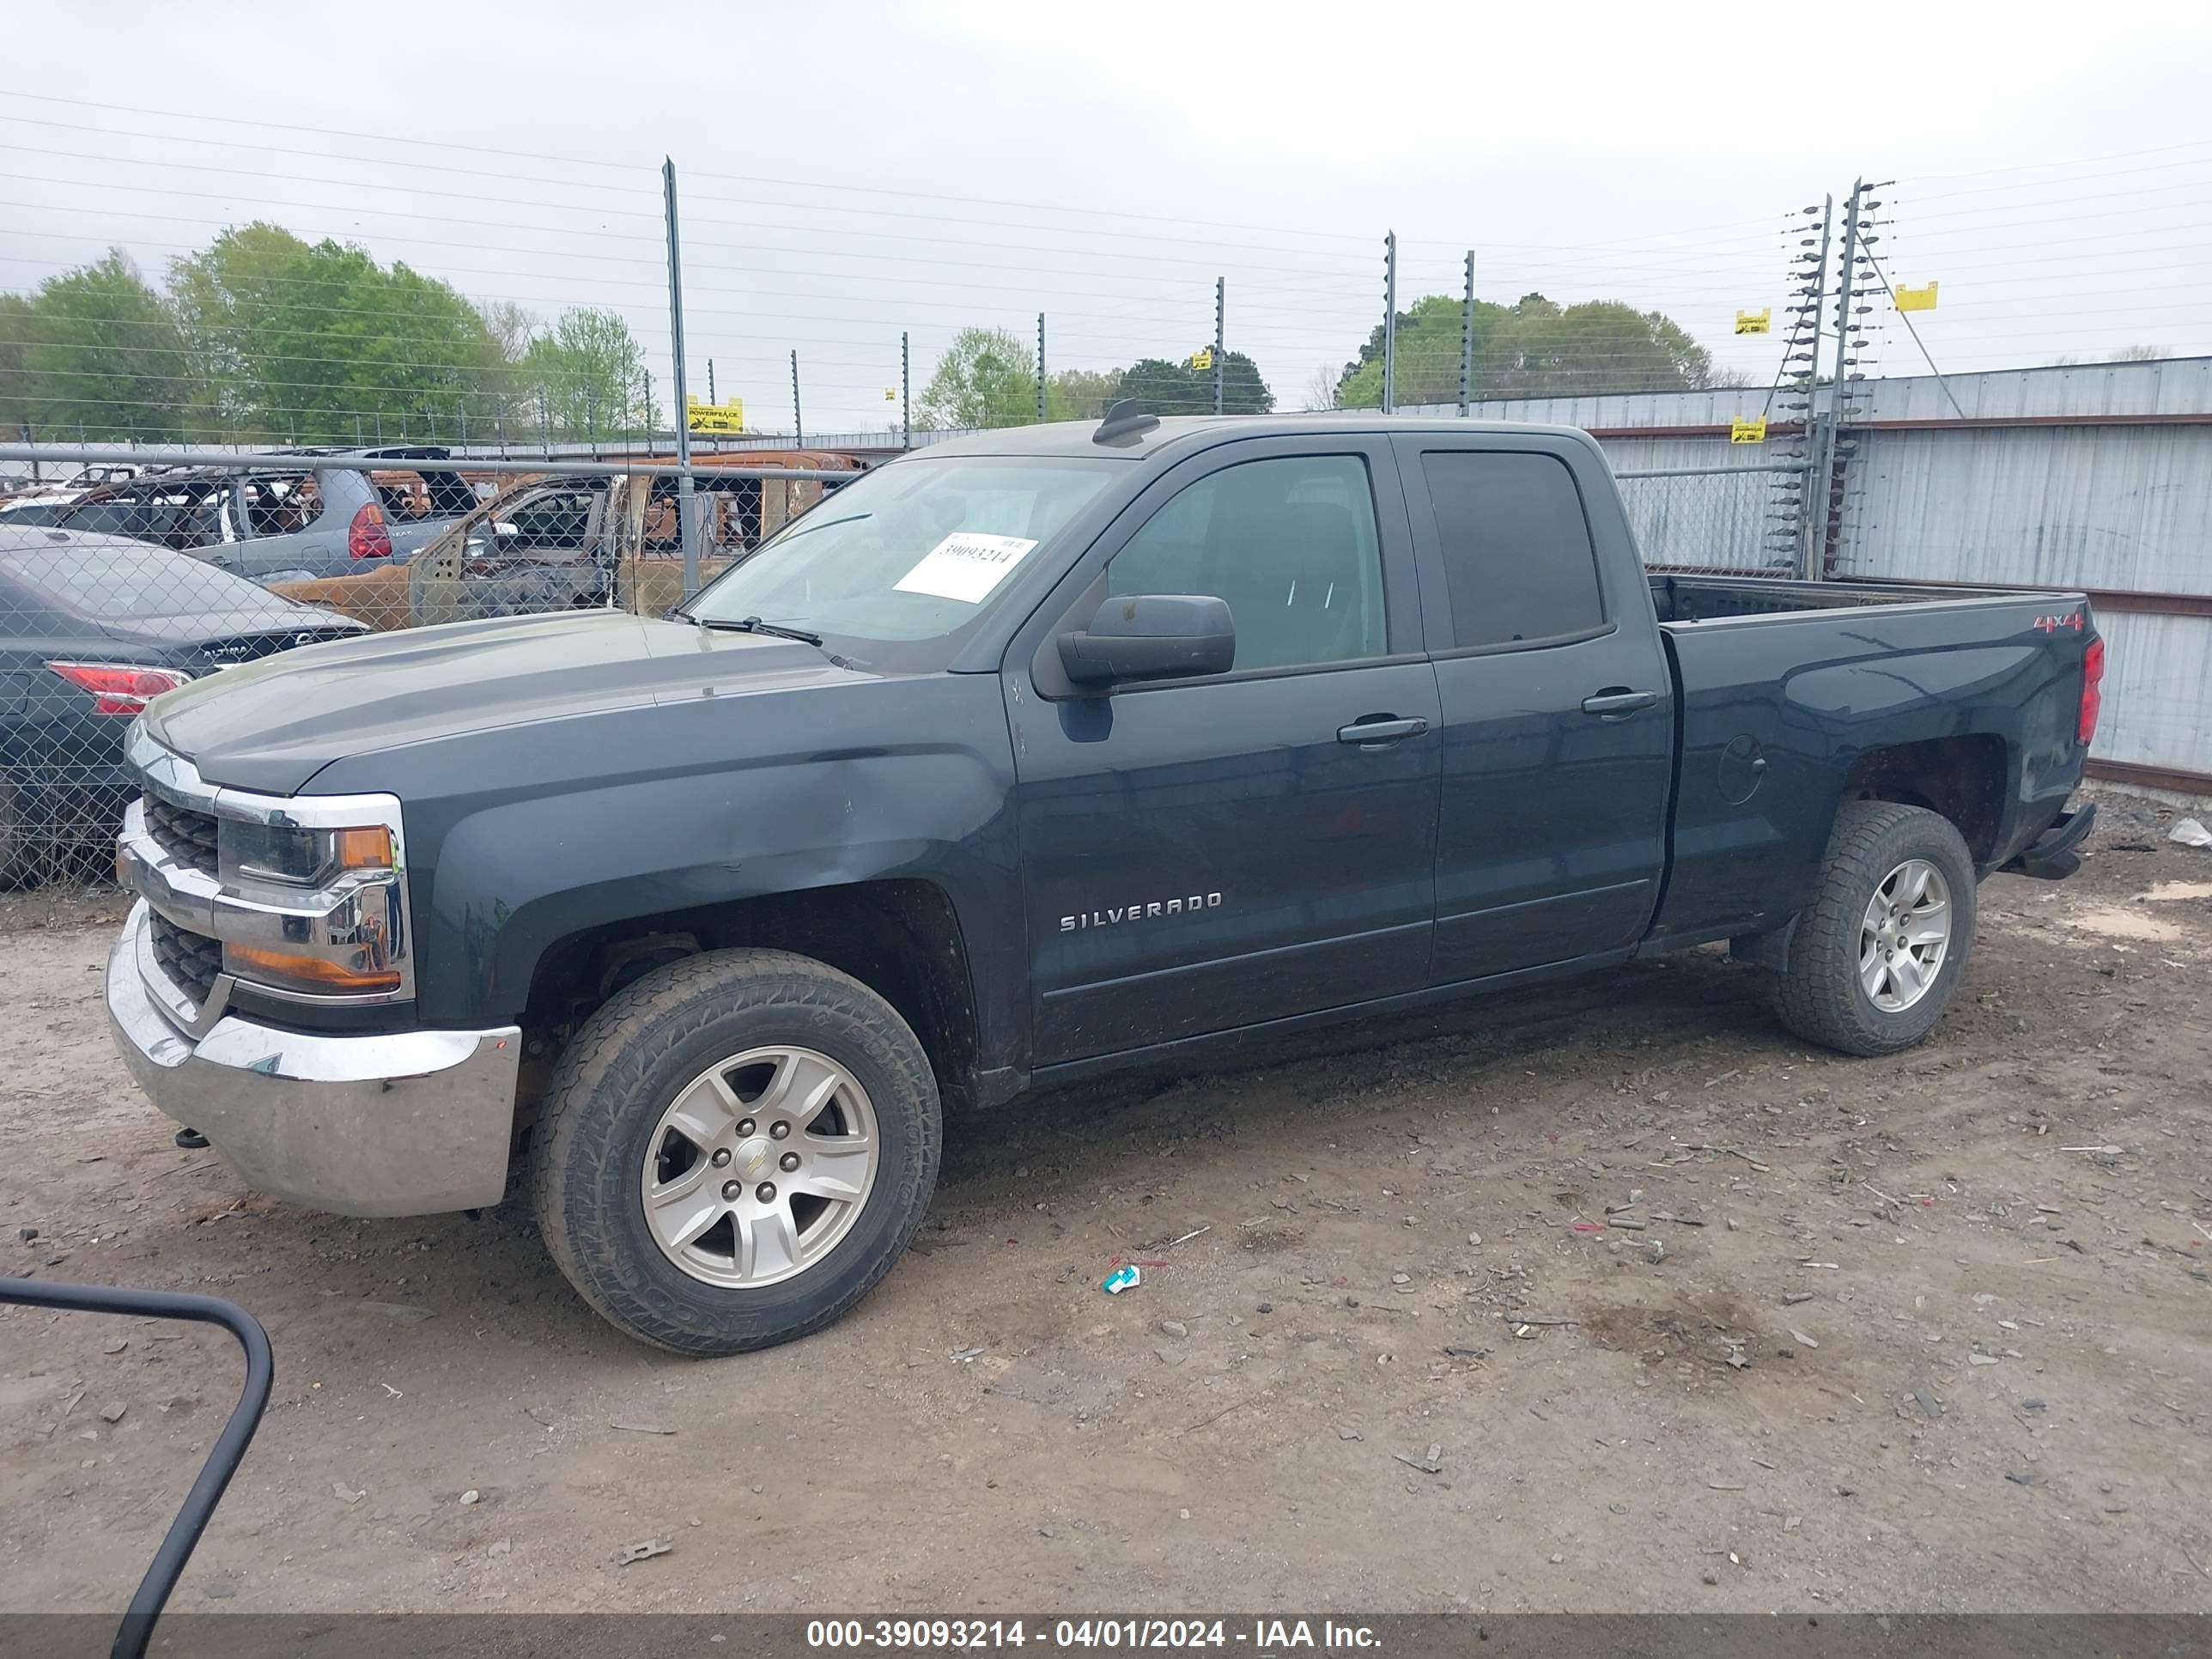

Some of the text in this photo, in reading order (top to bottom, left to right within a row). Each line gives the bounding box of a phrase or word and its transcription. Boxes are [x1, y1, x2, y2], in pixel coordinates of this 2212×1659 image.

[939, 544, 1012, 563] 39093214
[204, 645, 247, 659] ALTIMA
[1060, 892, 1221, 932] SILVERADO
